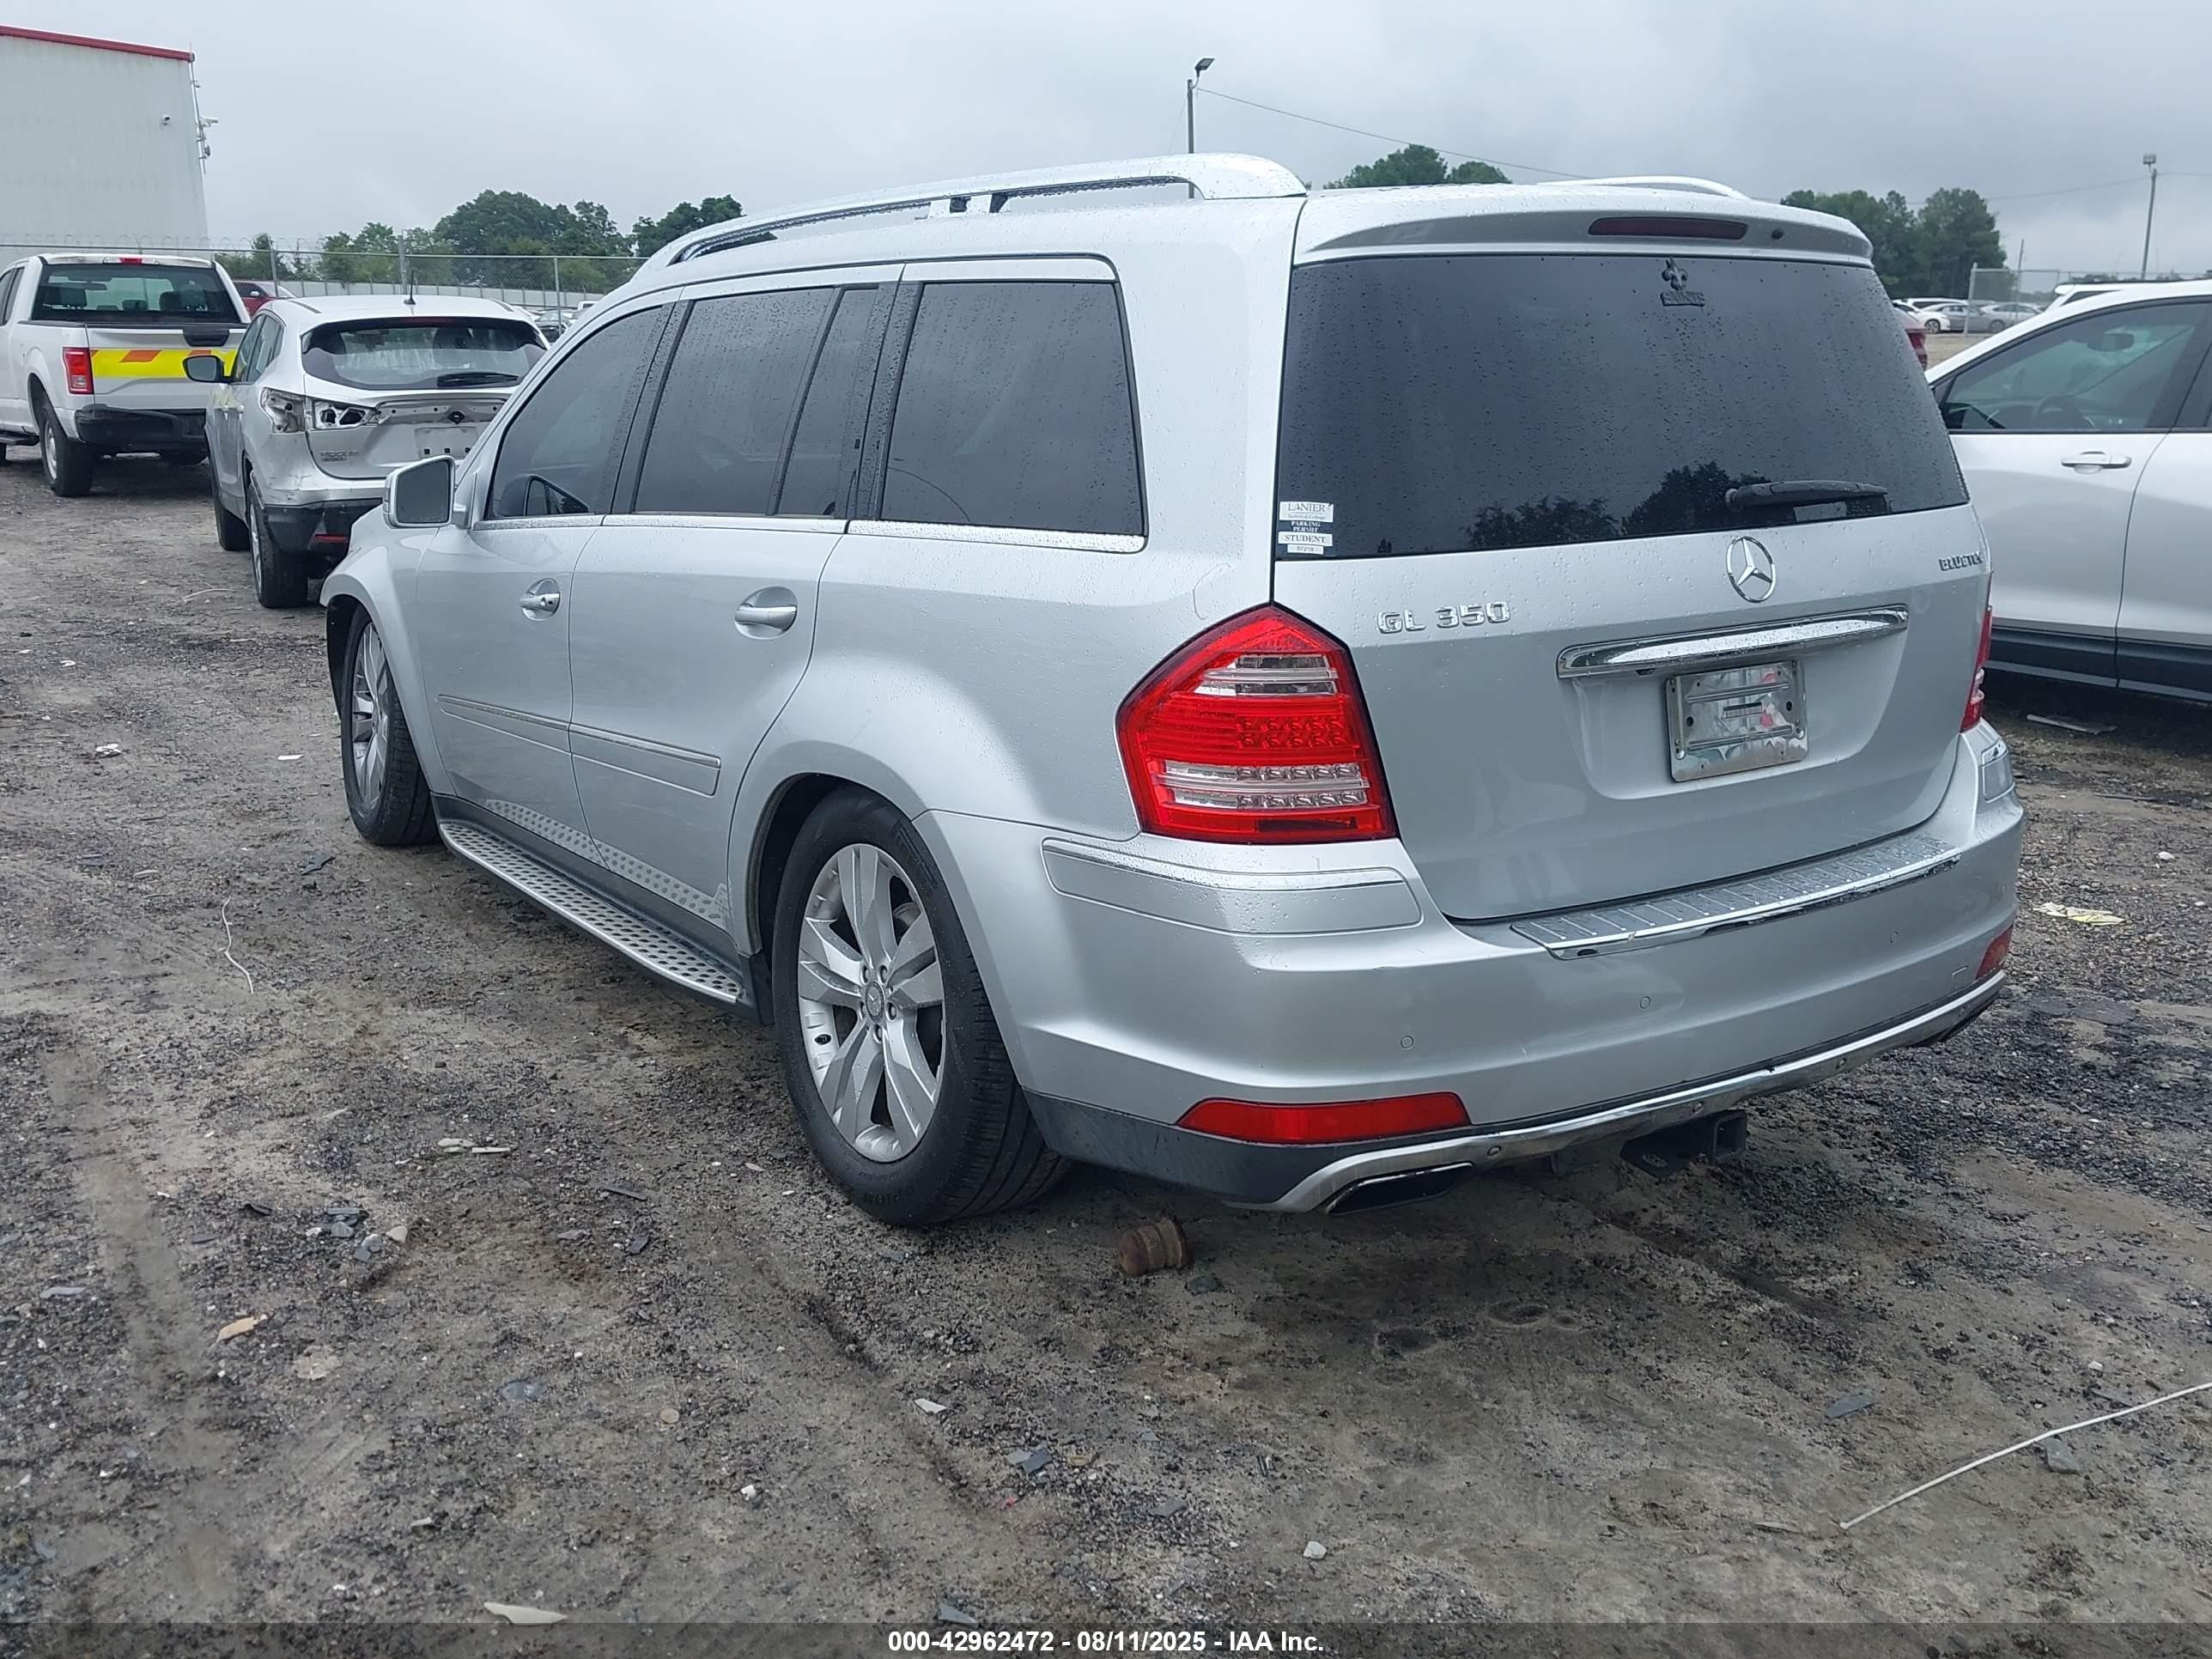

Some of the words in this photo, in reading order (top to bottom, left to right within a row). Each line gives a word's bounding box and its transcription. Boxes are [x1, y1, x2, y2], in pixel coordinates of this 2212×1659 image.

[1288, 502, 1326, 513] LANIER
[1377, 610, 1426, 634] GL
[1435, 601, 1510, 628] 350
